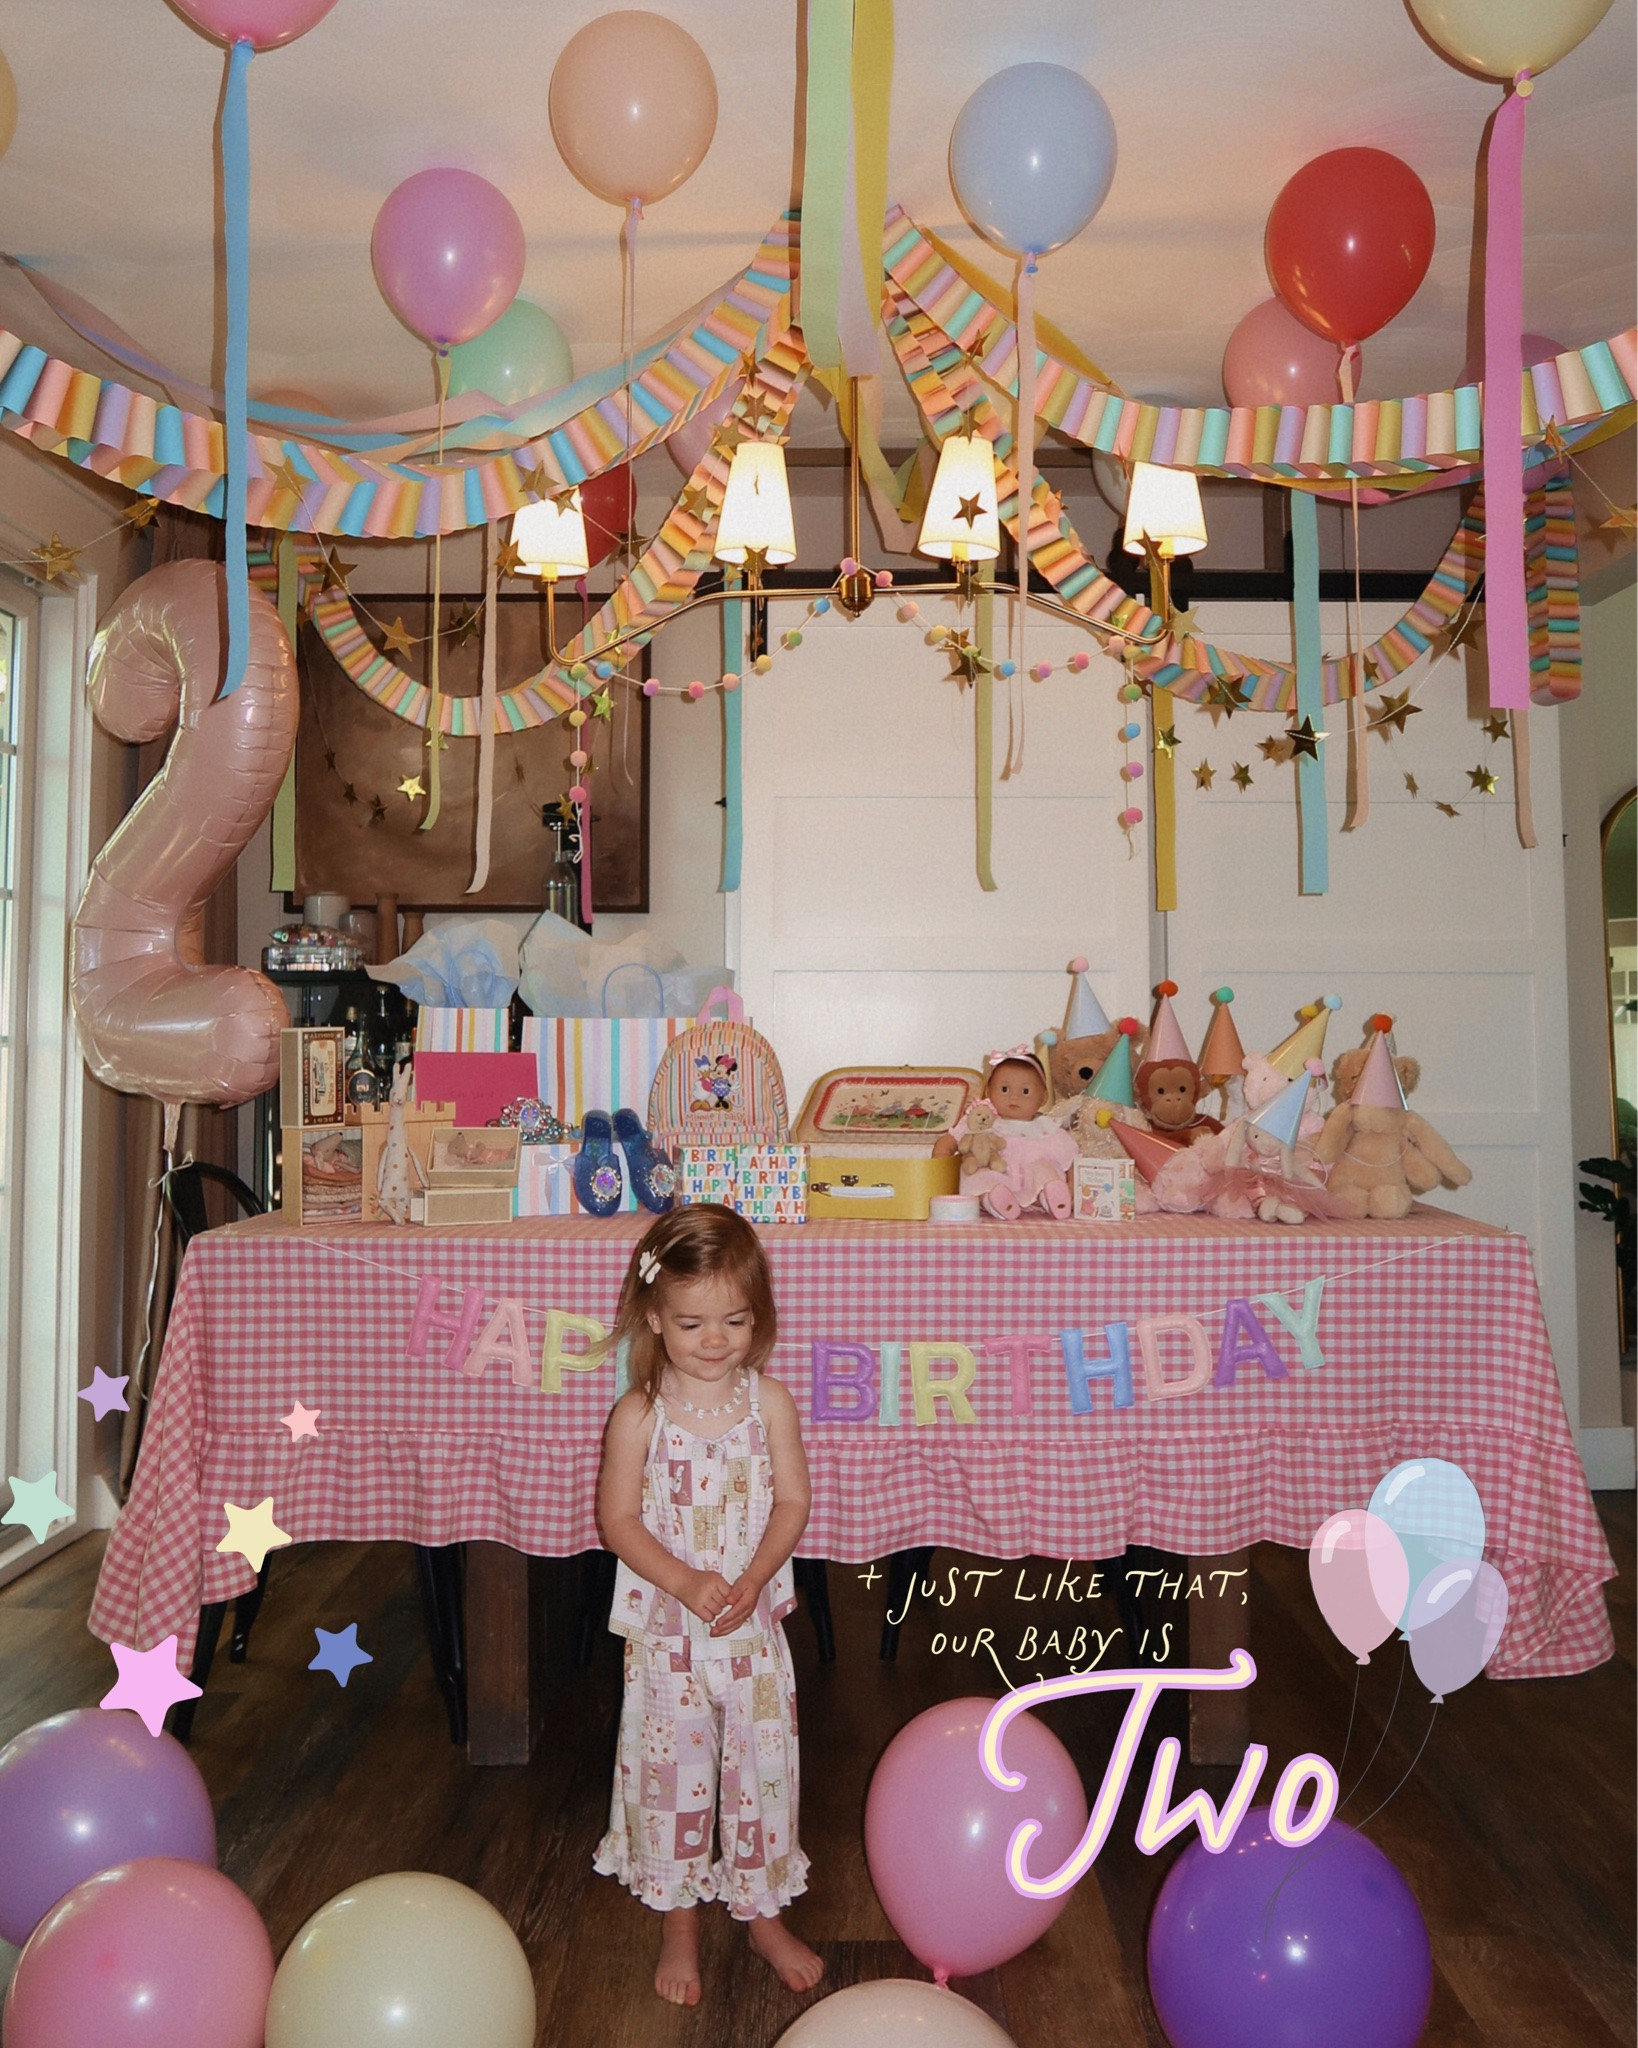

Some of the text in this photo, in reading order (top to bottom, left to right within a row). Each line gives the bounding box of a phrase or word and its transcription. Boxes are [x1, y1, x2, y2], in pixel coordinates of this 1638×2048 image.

[687, 1163, 731, 1177] HAPPY
[693, 1179, 735, 1193] HAPPY
[744, 1186, 789, 1199] HAPPY
[404, 1274, 1326, 1427] HAP BIRTHDAY
